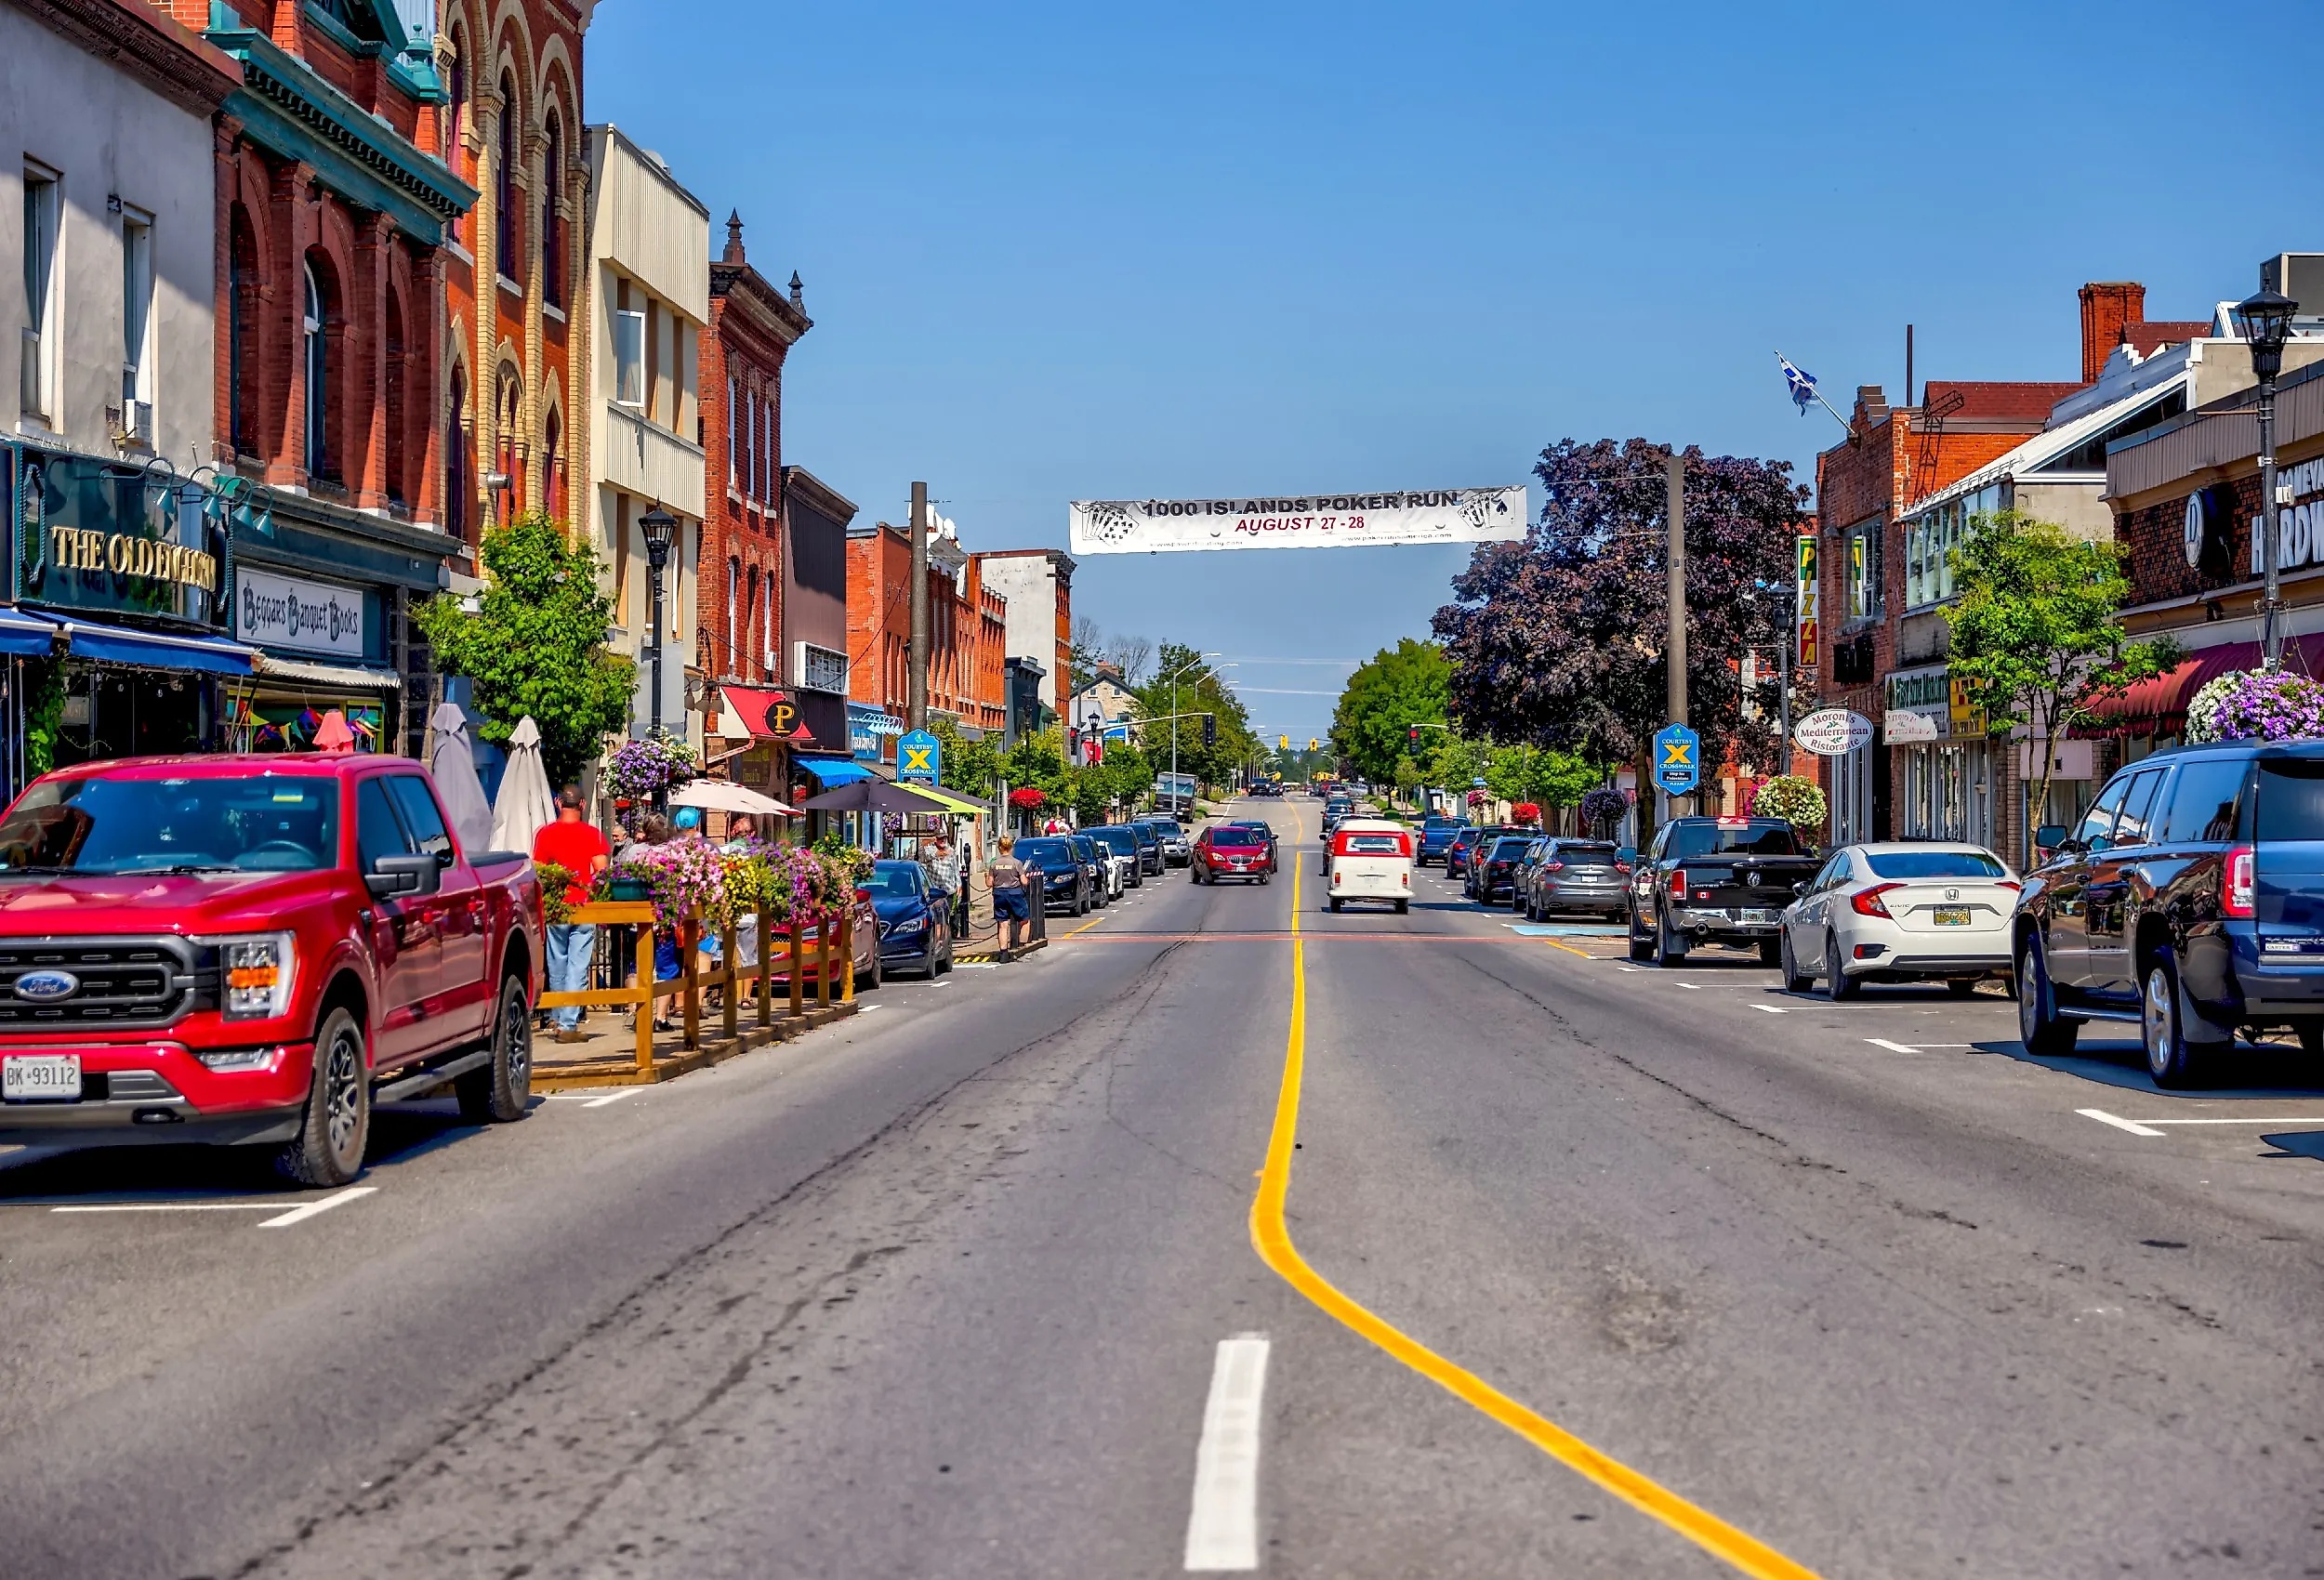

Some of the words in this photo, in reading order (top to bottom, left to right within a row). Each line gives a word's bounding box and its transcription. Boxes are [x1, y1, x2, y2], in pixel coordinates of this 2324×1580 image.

[1142, 502, 1199, 517] 1000
[1206, 498, 1308, 516] ISLANDS
[1316, 494, 1399, 511] POKER
[1407, 492, 1457, 509] RUN
[1235, 517, 1315, 533] AUGUST
[1320, 517, 1337, 530] 27
[1348, 516, 1365, 529] 28
[52, 525, 105, 572] THE
[109, 533, 154, 576] OLD
[1801, 546, 1816, 664] PIZZA
[329, 599, 358, 642] Books
[773, 704, 795, 733] P
[1812, 712, 1856, 725] Moroni's
[1801, 728, 1868, 738] Mediterranean
[1811, 738, 1860, 751] Ristorante
[28, 979, 60, 994] Ford
[7, 1067, 23, 1086] BK
[33, 1067, 75, 1085] 93112
